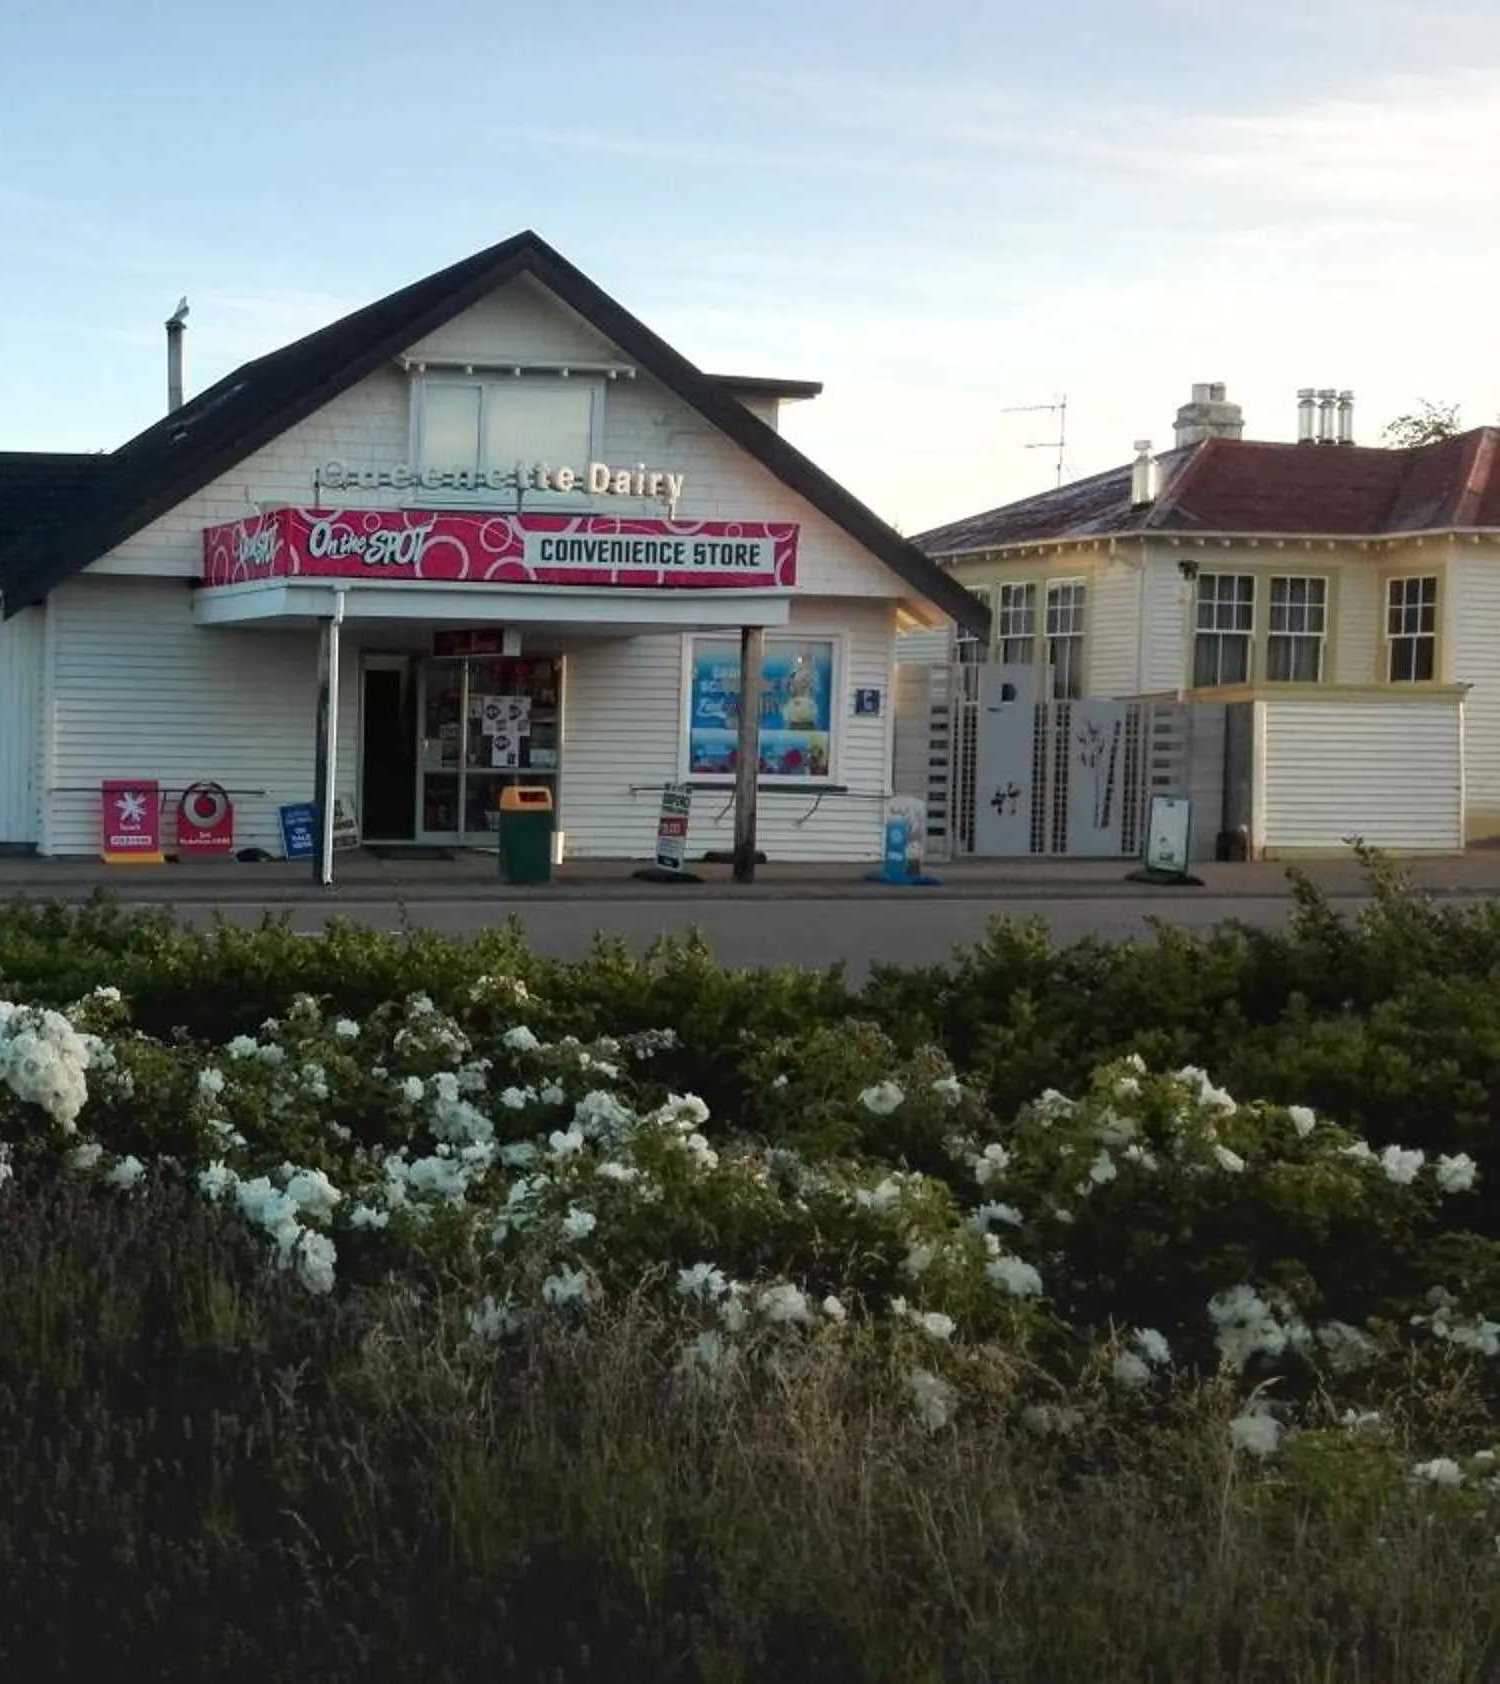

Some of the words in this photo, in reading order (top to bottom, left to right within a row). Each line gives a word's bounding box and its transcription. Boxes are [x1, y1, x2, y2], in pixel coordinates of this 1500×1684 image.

[588, 462, 684, 505] Dairy
[364, 525, 434, 564] SPOT
[540, 538, 684, 565] CONVENIENCE
[692, 543, 761, 567] STORE
